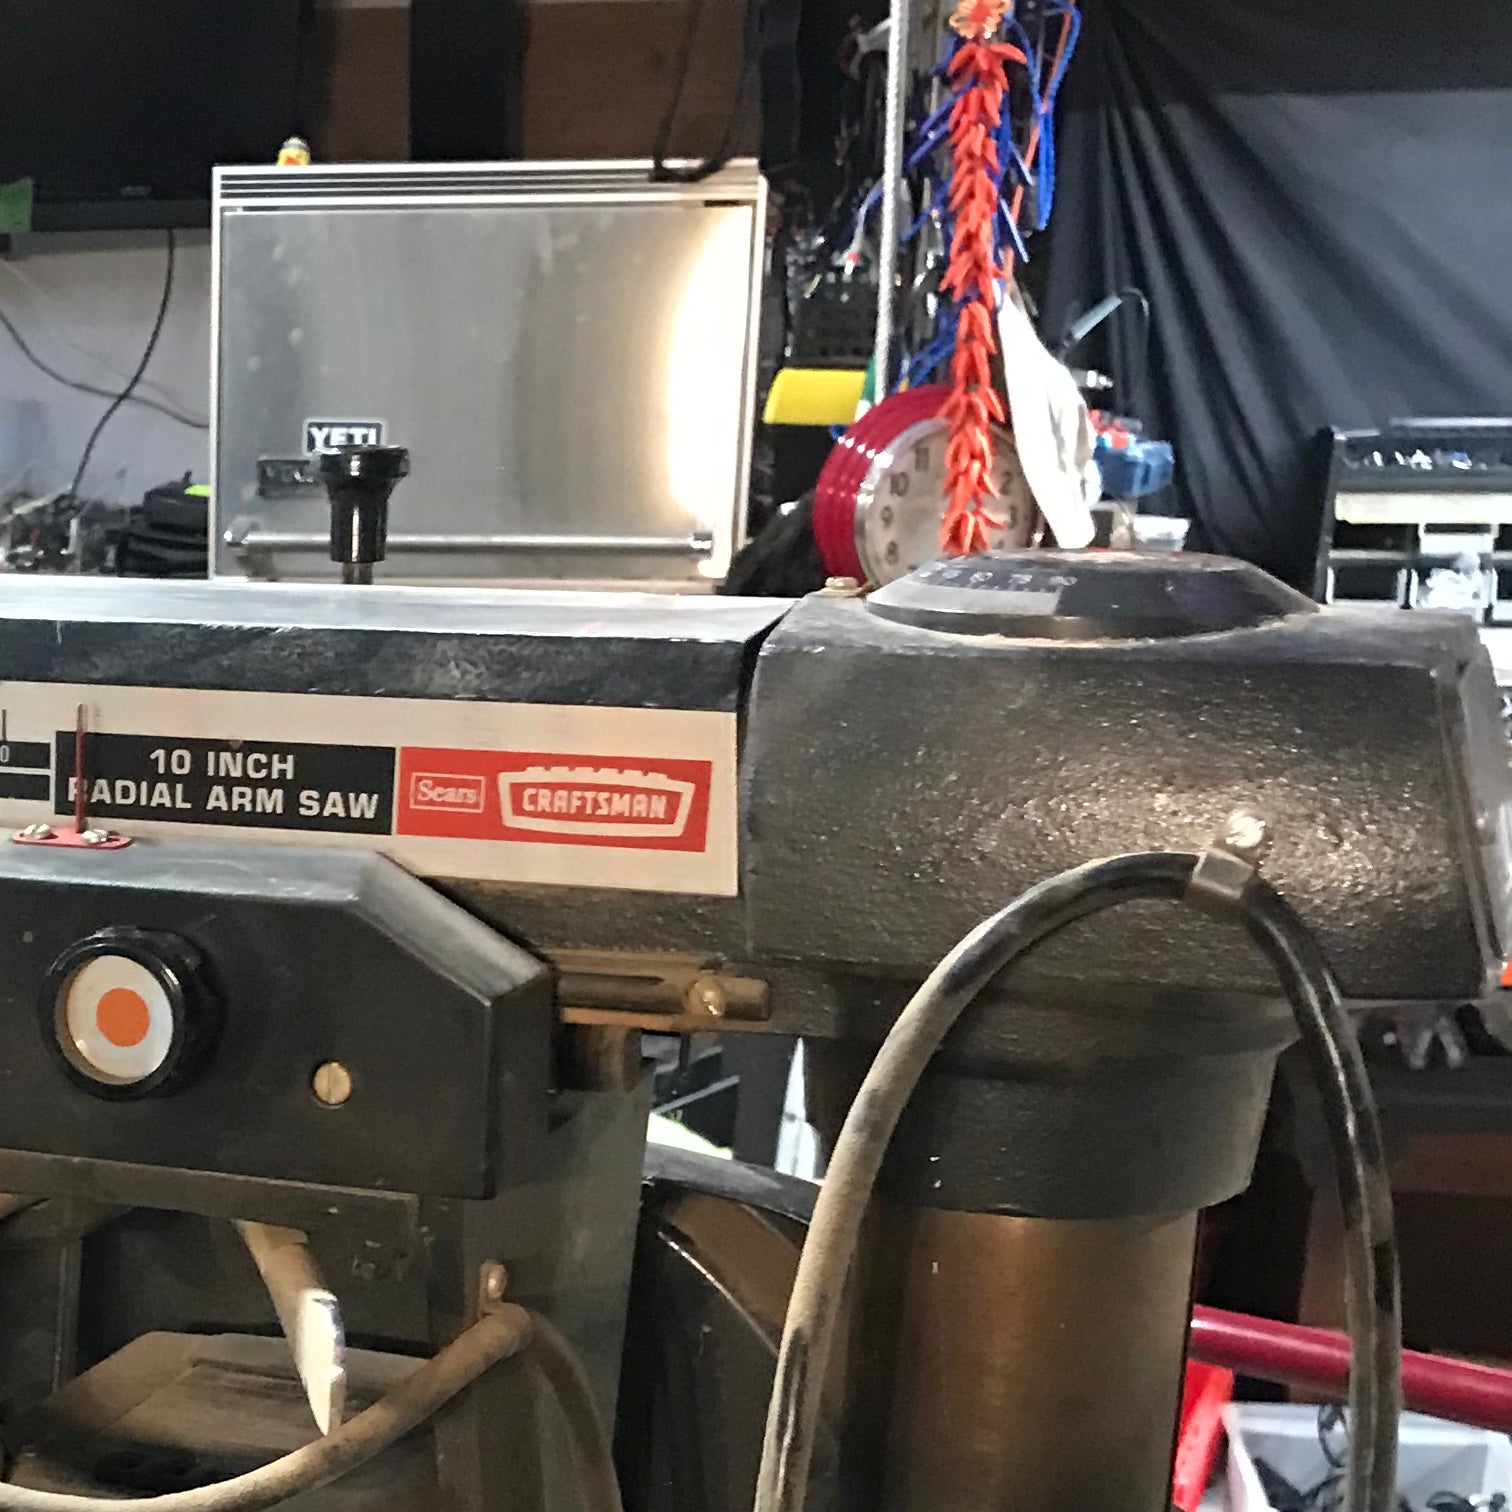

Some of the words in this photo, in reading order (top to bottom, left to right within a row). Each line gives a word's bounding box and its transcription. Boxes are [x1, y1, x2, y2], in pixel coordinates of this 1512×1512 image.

[309, 427, 377, 448] YETI
[889, 471, 910, 497] 10
[880, 504, 895, 530] 9
[149, 748, 192, 775] 10
[206, 751, 295, 780] INCH
[205, 785, 284, 814] ARM
[298, 789, 379, 819] SAW
[417, 779, 478, 804] Sears
[522, 787, 668, 819] CRAFTSMAN
